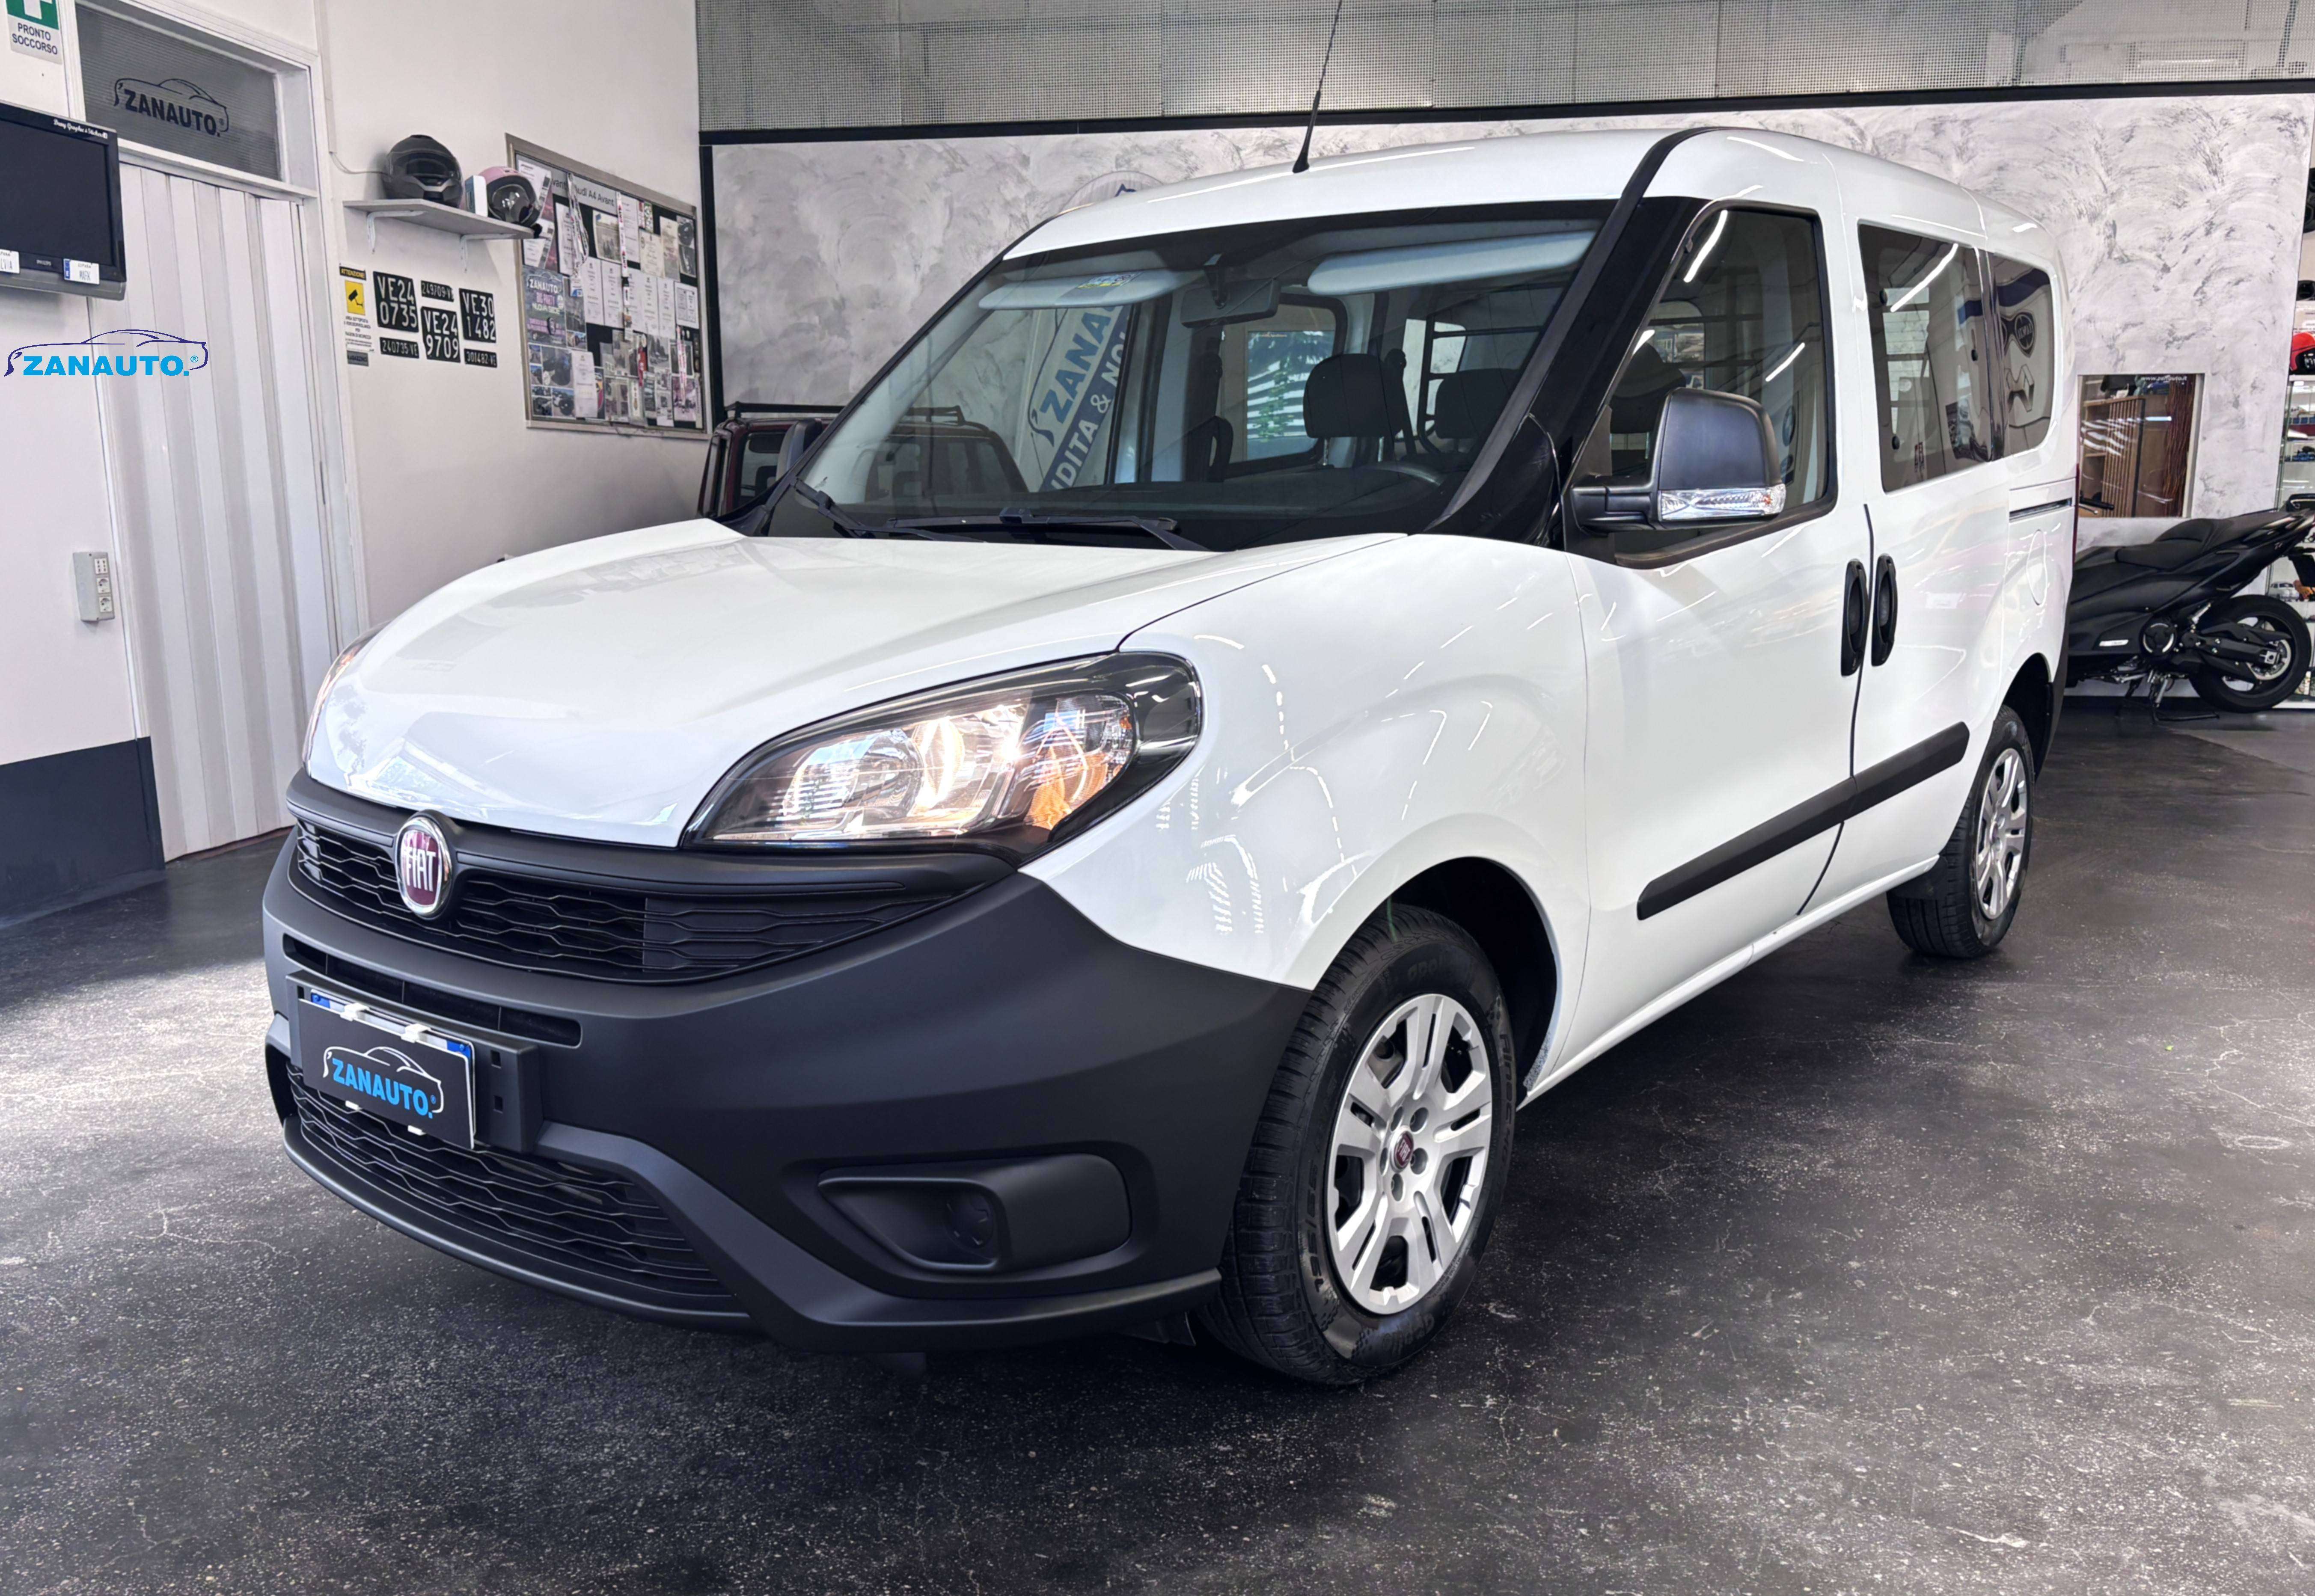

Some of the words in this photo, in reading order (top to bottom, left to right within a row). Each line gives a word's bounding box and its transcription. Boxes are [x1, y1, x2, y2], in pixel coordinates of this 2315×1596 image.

[12, 33, 58, 55] SOCCORSO
[18, 22, 51, 41] PRONTO
[124, 88, 220, 137] ZANAUTO.
[597, 193, 614, 206] Avant
[377, 276, 414, 304] VE24
[379, 301, 417, 328] 0735
[462, 292, 494, 317] VE30
[424, 309, 458, 336] VE24
[467, 316, 496, 341] 1482
[426, 334, 459, 359] 9709
[1040, 306, 1115, 424] ZANA
[1090, 393, 1112, 413] &
[1101, 332, 1126, 388] NO
[405, 846, 437, 892] FIAT
[332, 1058, 433, 1119] ZANAUTO.
